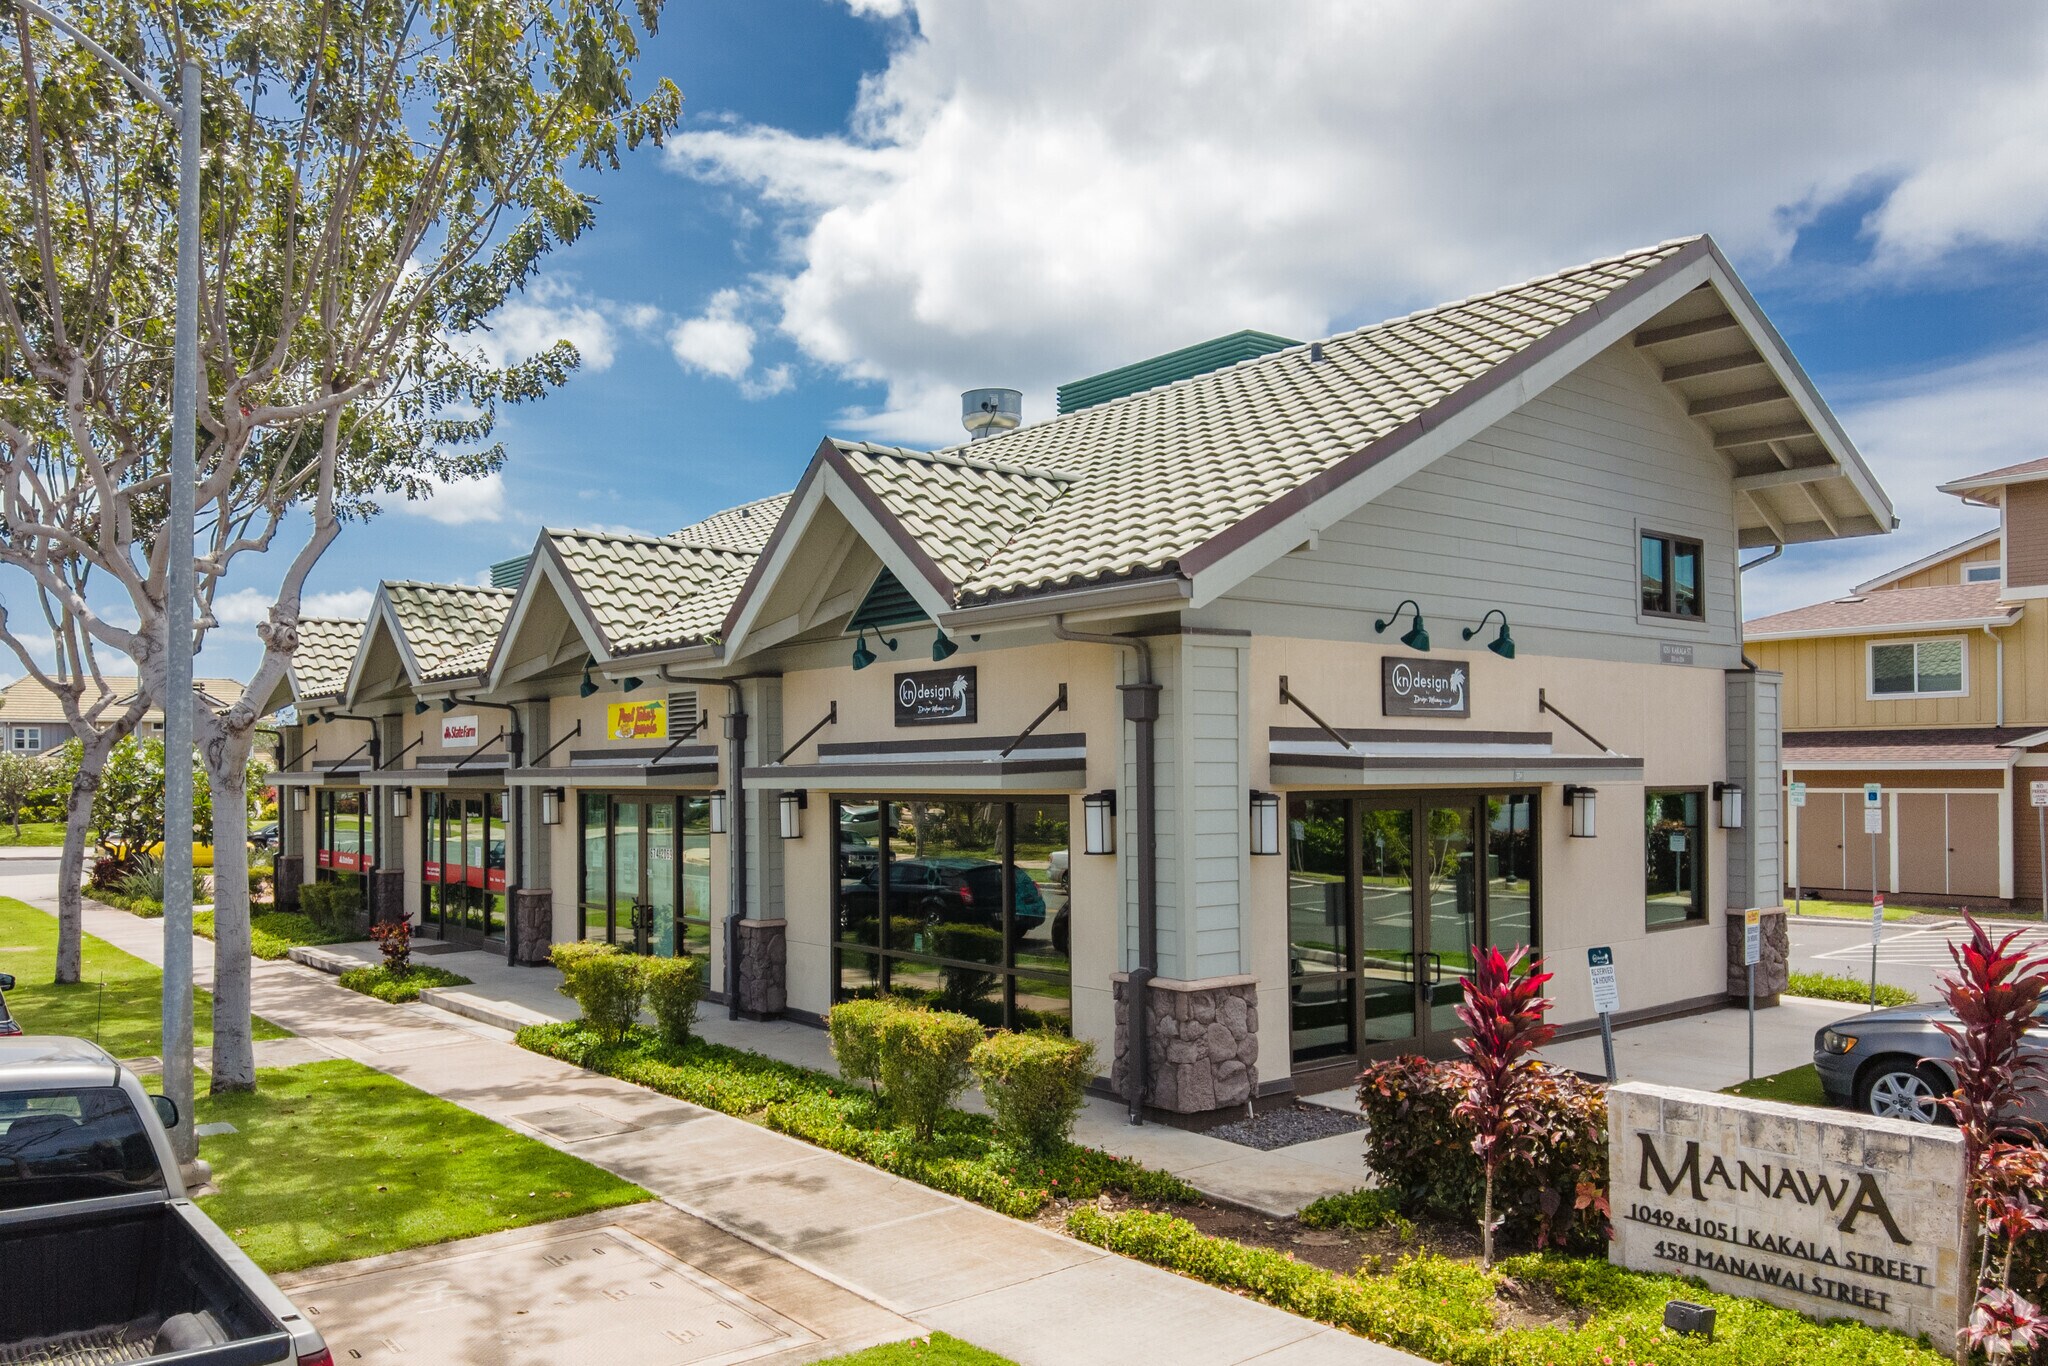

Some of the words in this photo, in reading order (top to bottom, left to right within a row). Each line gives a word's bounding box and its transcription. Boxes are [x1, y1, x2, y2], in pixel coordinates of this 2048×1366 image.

[1413, 671, 1448, 692] design
[917, 683, 951, 701] design
[1591, 966, 1614, 977] RESERVED
[1592, 977, 1599, 985] 24
[1599, 975, 1615, 985] HOURS
[1631, 1203, 1674, 1228] 1049
[1676, 1217, 1692, 1233] &
[1695, 1217, 1738, 1242] 1051
[1748, 1229, 1839, 1266] KAKALA
[1845, 1250, 1928, 1285] STREET
[1654, 1240, 1689, 1263] 458
[1696, 1249, 1804, 1291] MANAWAI
[1811, 1276, 1891, 1313] STREET
